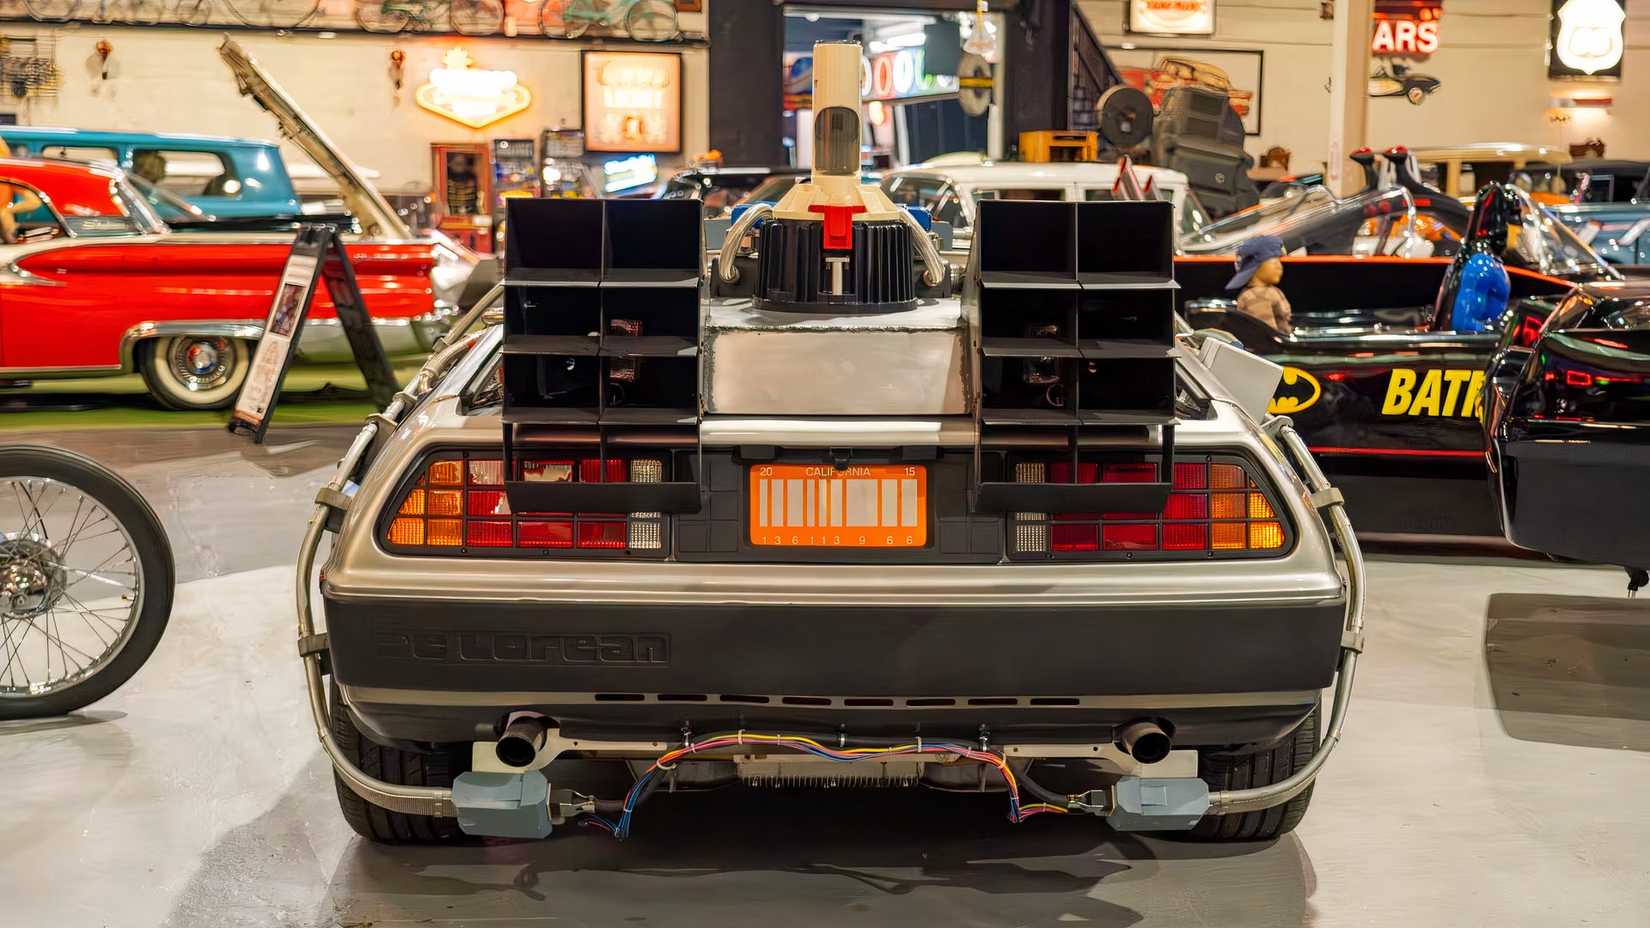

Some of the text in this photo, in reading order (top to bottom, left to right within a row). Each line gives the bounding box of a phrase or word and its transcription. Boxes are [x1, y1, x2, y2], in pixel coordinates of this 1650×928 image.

[1372, 19, 1439, 53] ARS
[759, 467, 773, 477] 20
[904, 467, 916, 477] 15
